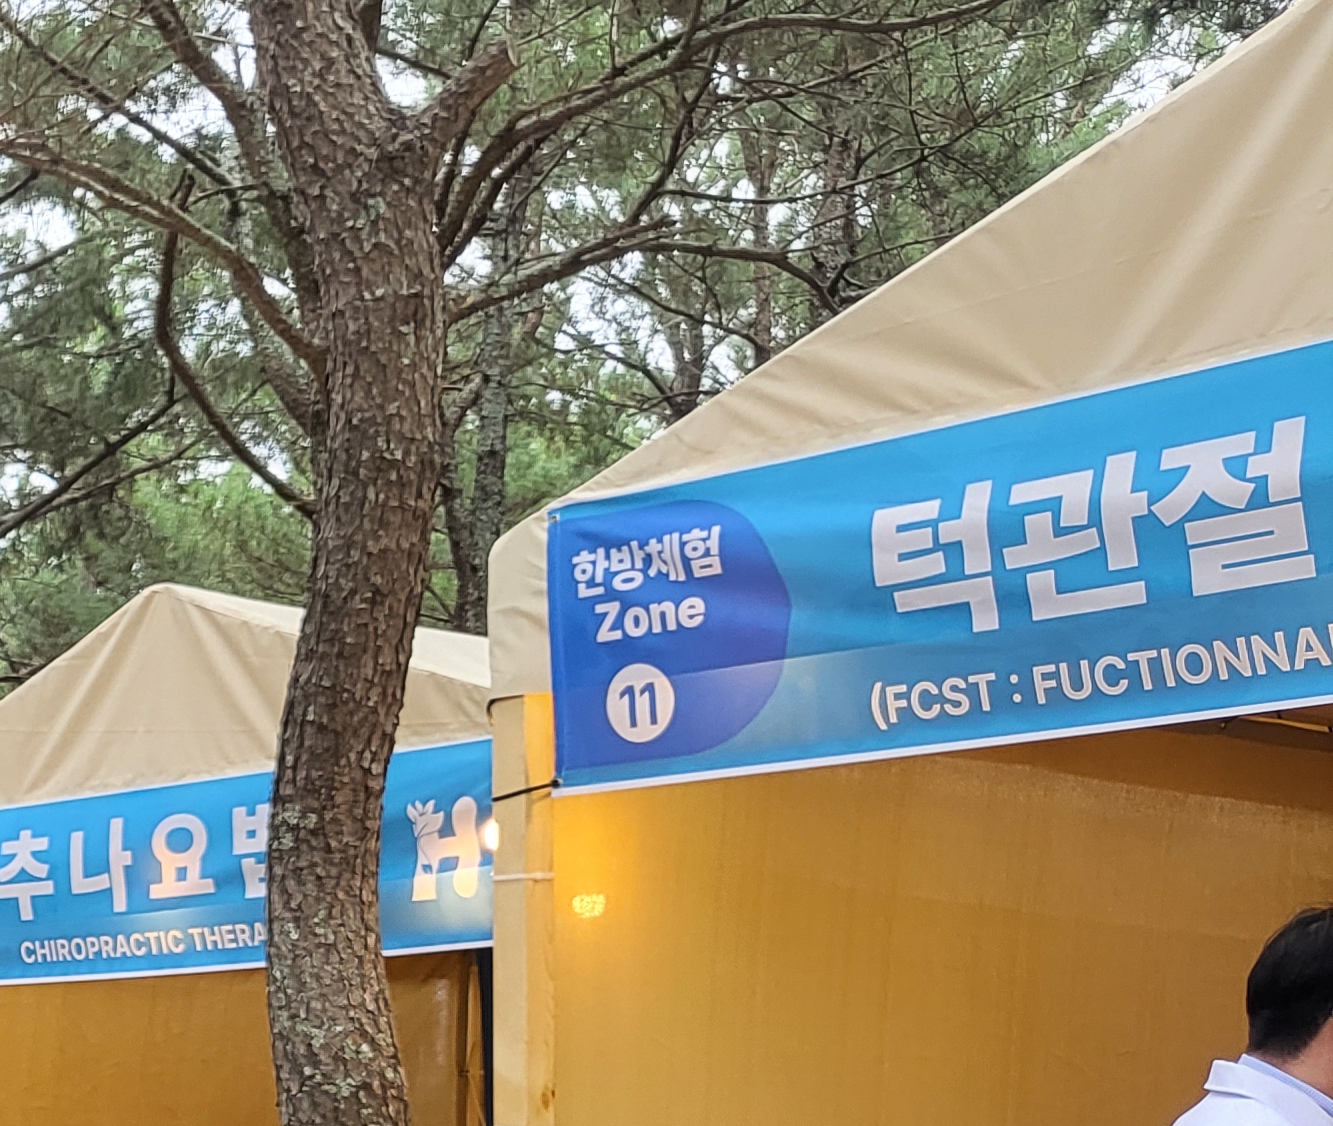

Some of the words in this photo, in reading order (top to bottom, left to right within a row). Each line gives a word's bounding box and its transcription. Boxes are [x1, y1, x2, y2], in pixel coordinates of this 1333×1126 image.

[871, 416, 1316, 633] 턱관절
[572, 525, 723, 598] 한방체험
[594, 596, 706, 643] Zone
[1033, 623, 1333, 704] FUCTIONNA
[619, 682, 658, 728] 11
[20, 928, 186, 963] CHIROPRACTIC
